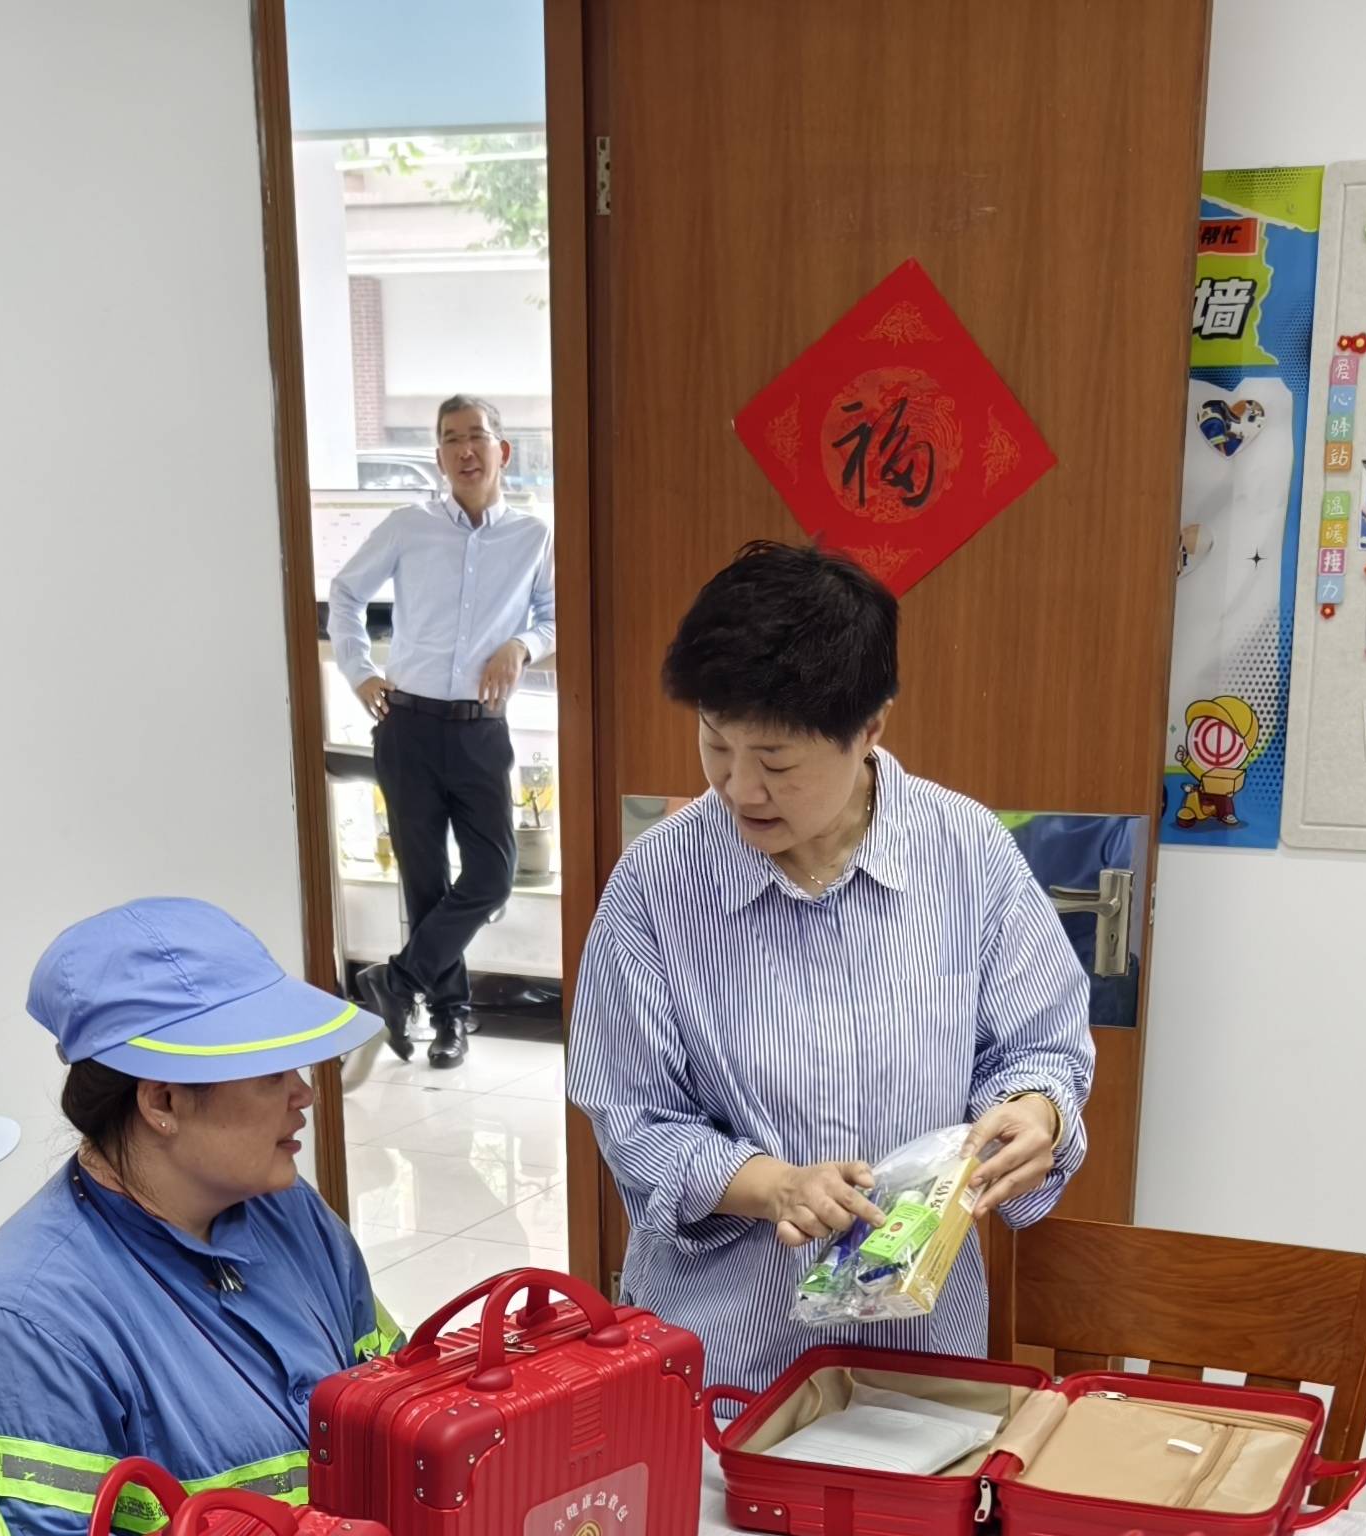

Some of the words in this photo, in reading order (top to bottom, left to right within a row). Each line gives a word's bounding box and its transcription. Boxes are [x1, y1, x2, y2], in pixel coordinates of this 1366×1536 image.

[1193, 278, 1255, 337] 墙
[831, 396, 936, 508] 福
[1327, 358, 1352, 466] 爱心驿站
[1322, 498, 1346, 599] 温暖接力
